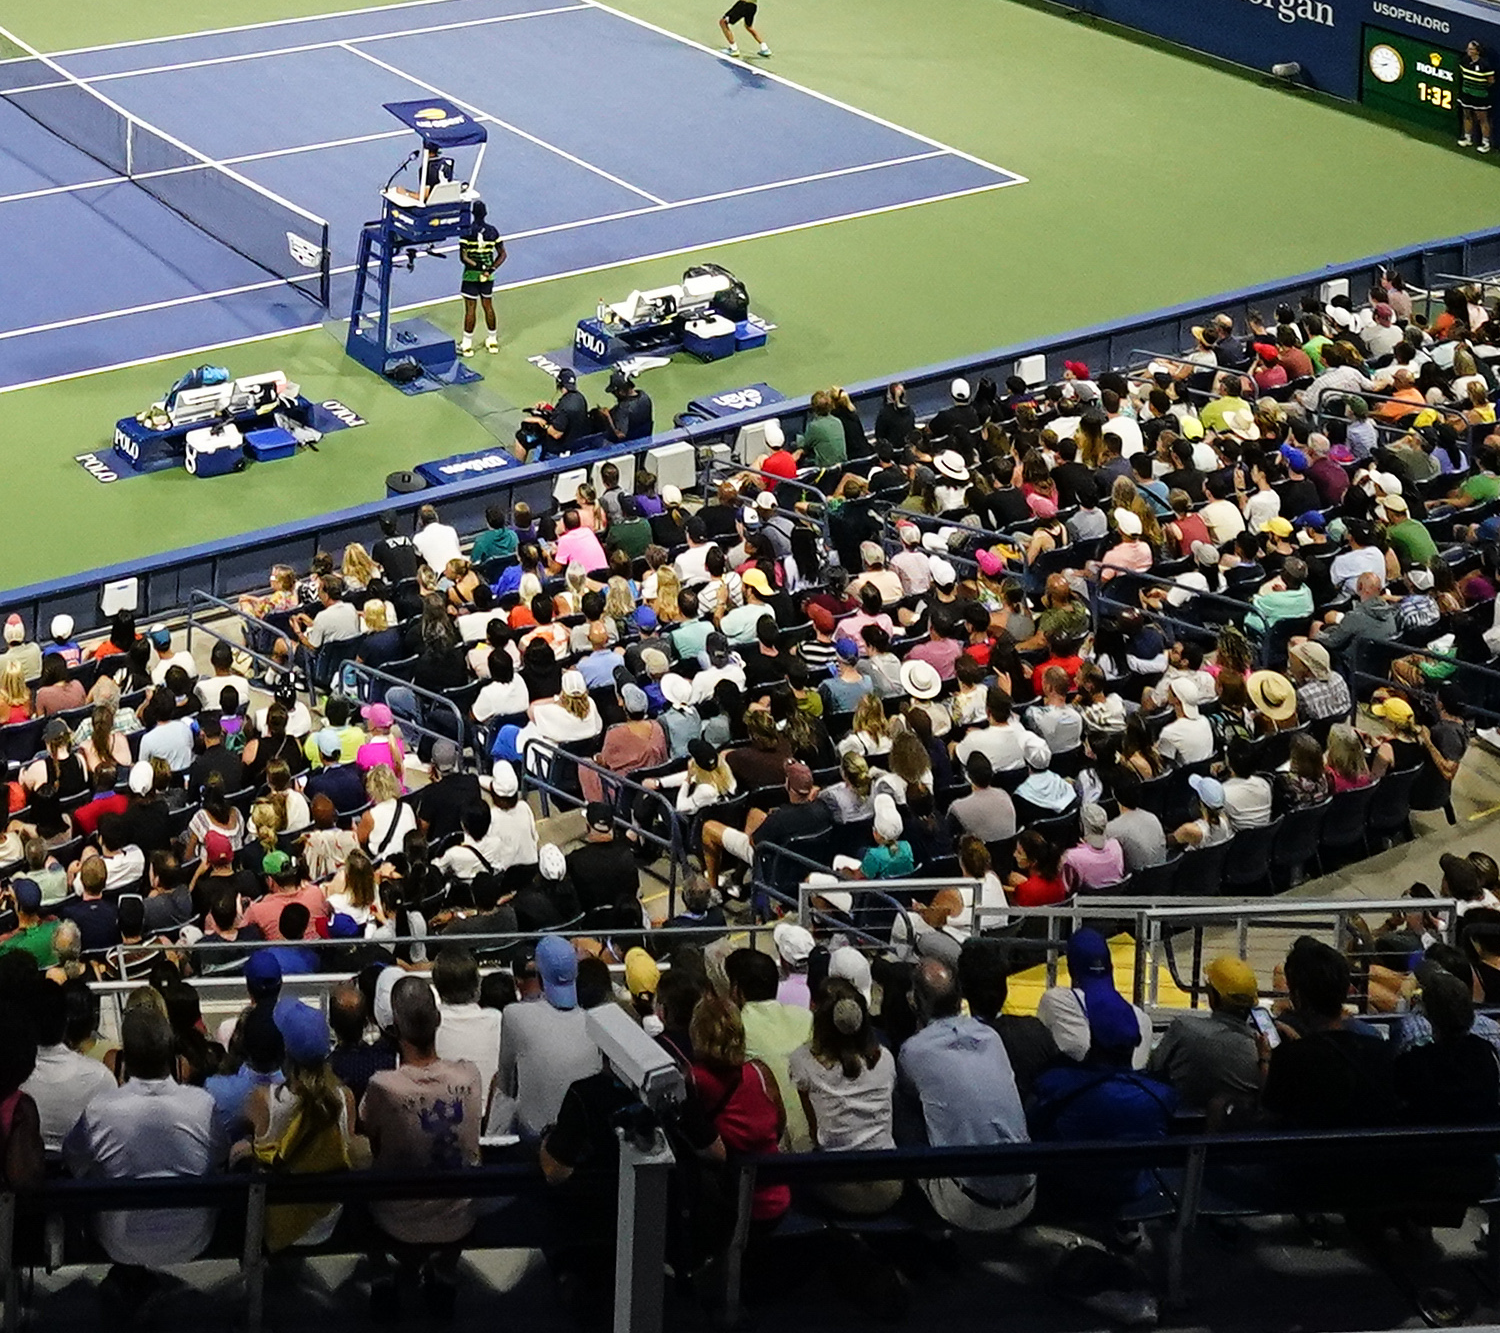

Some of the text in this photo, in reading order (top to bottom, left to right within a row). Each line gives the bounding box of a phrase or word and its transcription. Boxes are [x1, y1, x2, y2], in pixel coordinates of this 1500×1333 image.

[1373, 0, 1450, 34] USOPEN.ORG
[1416, 61, 1454, 82] ROLEX
[1418, 82, 1452, 110] 1:32
[576, 328, 605, 356] POLO
[321, 399, 367, 428] POLO
[114, 428, 140, 461] POLO
[75, 453, 118, 483] POLO
